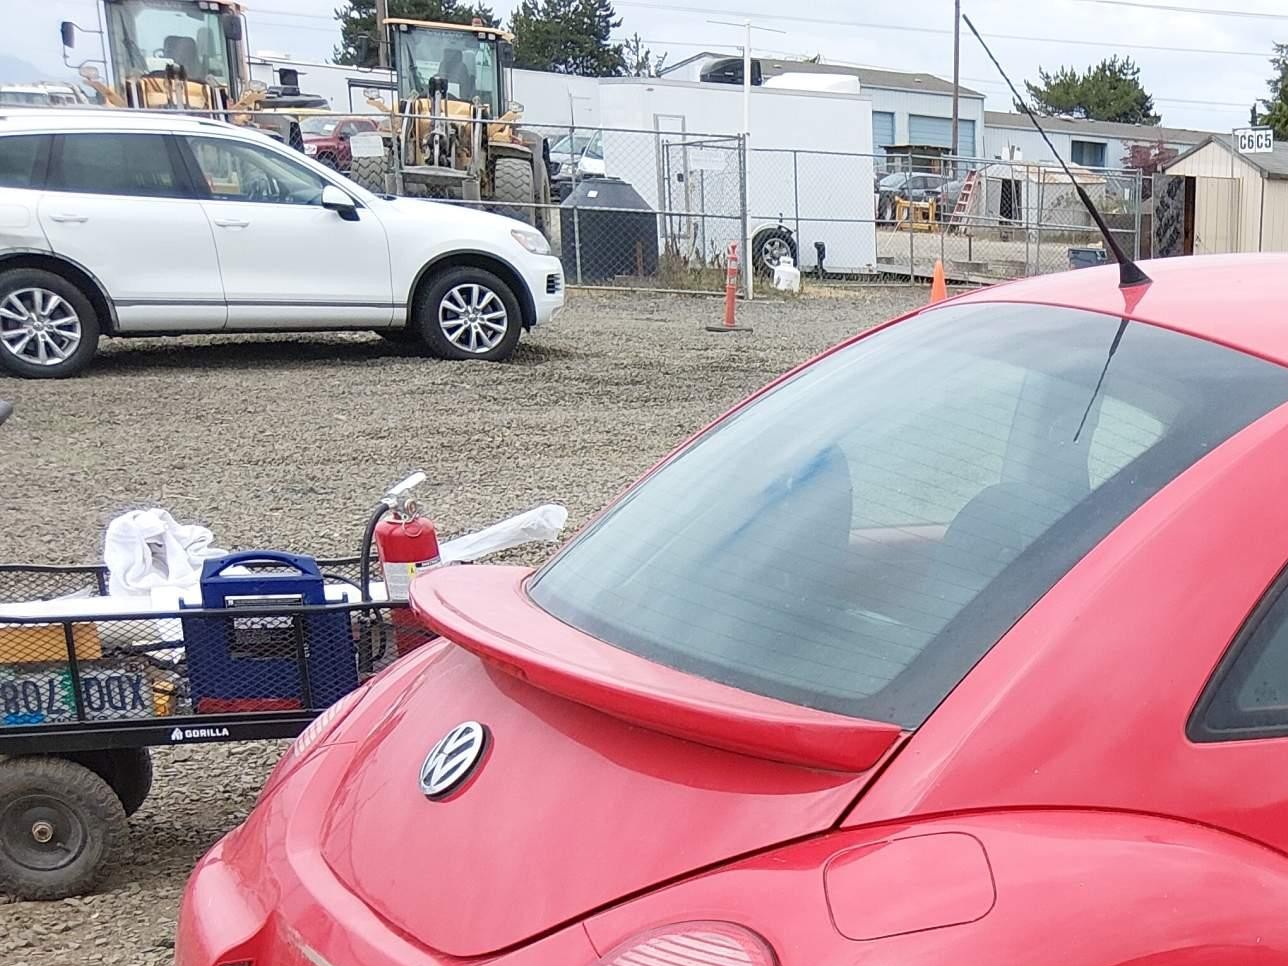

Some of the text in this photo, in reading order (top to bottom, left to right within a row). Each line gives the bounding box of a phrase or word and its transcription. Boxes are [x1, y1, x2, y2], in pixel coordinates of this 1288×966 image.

[1240, 134, 1254, 150] C6
[1256, 133, 1272, 149] C5
[184, 727, 230, 738] GORILLA
